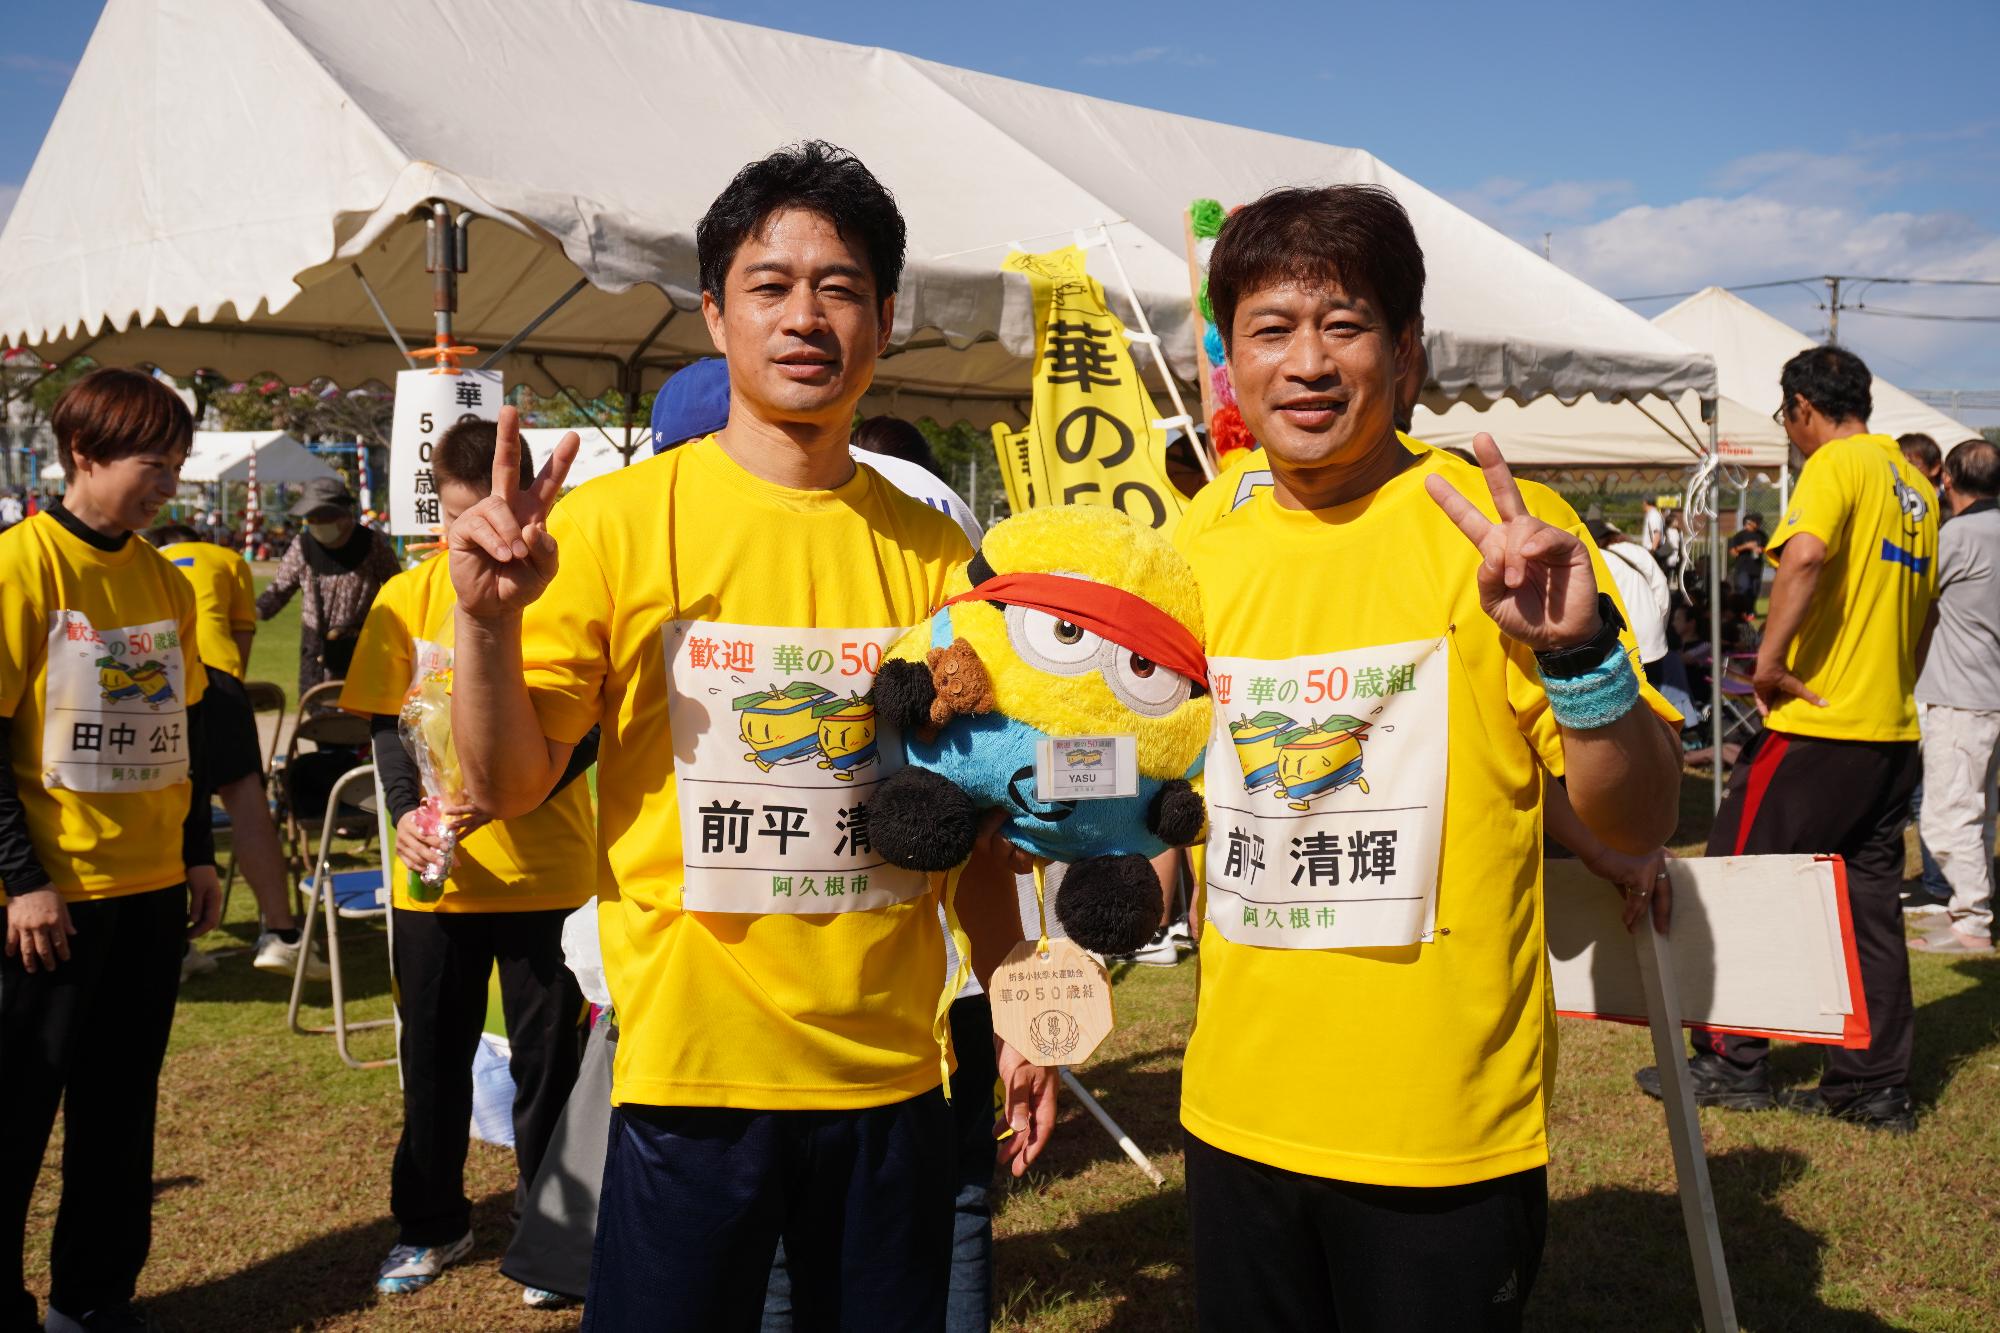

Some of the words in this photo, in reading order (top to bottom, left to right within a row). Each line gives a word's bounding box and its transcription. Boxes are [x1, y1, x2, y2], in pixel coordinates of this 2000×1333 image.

[688, 636, 755, 673] 歓迎
[1247, 663, 1417, 705] 華の50歳組
[73, 722, 136, 755] 田中
[149, 723, 181, 753] 公子
[1069, 774, 1097, 783] YASU
[698, 800, 810, 856] 前平
[1290, 830, 1398, 887] 清輝
[772, 875, 869, 897] 阿久根市
[1243, 905, 1336, 929] 阿久根市
